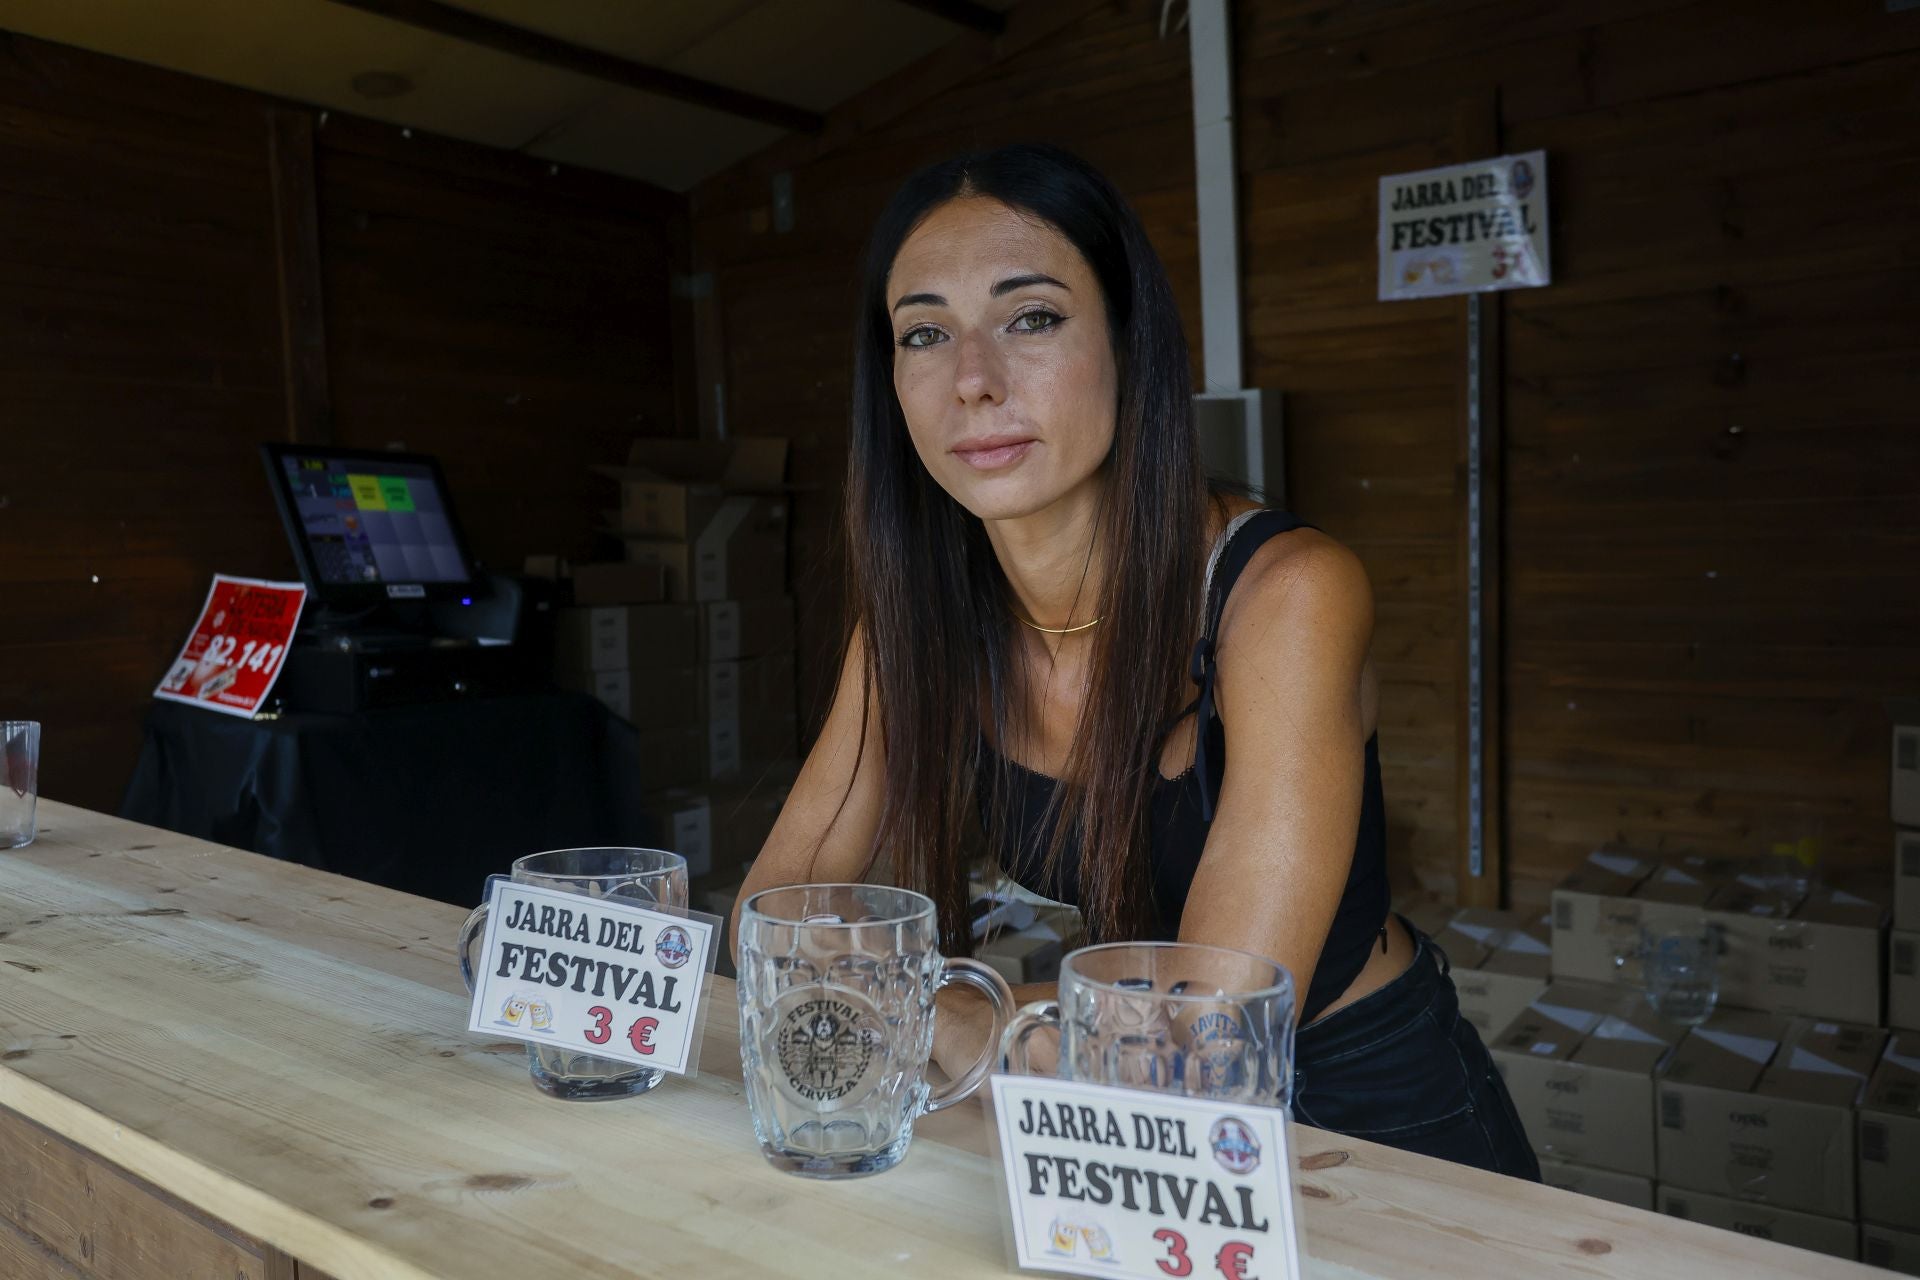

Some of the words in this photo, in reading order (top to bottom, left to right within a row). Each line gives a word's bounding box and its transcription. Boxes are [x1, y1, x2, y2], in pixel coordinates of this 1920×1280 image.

[1392, 178, 1457, 211] JARRA
[1461, 174, 1499, 201] DEL
[1391, 204, 1537, 251] FESTIVAL
[201, 634, 284, 675] 82.141
[506, 900, 590, 944] JARRA
[596, 917, 645, 955] DEL
[496, 941, 682, 1014] FESTIVAL
[584, 1005, 613, 1045] 3
[627, 1016, 660, 1055] €
[787, 999, 860, 1024] FESTIVAL
[789, 1077, 858, 1101] CERVEZA
[1019, 1099, 1126, 1148] JARRA
[1131, 1113, 1196, 1159] DEL
[1023, 1153, 1269, 1233] FESTIVAL
[1153, 1227, 1193, 1277] 3
[1216, 1240, 1260, 1280] €
